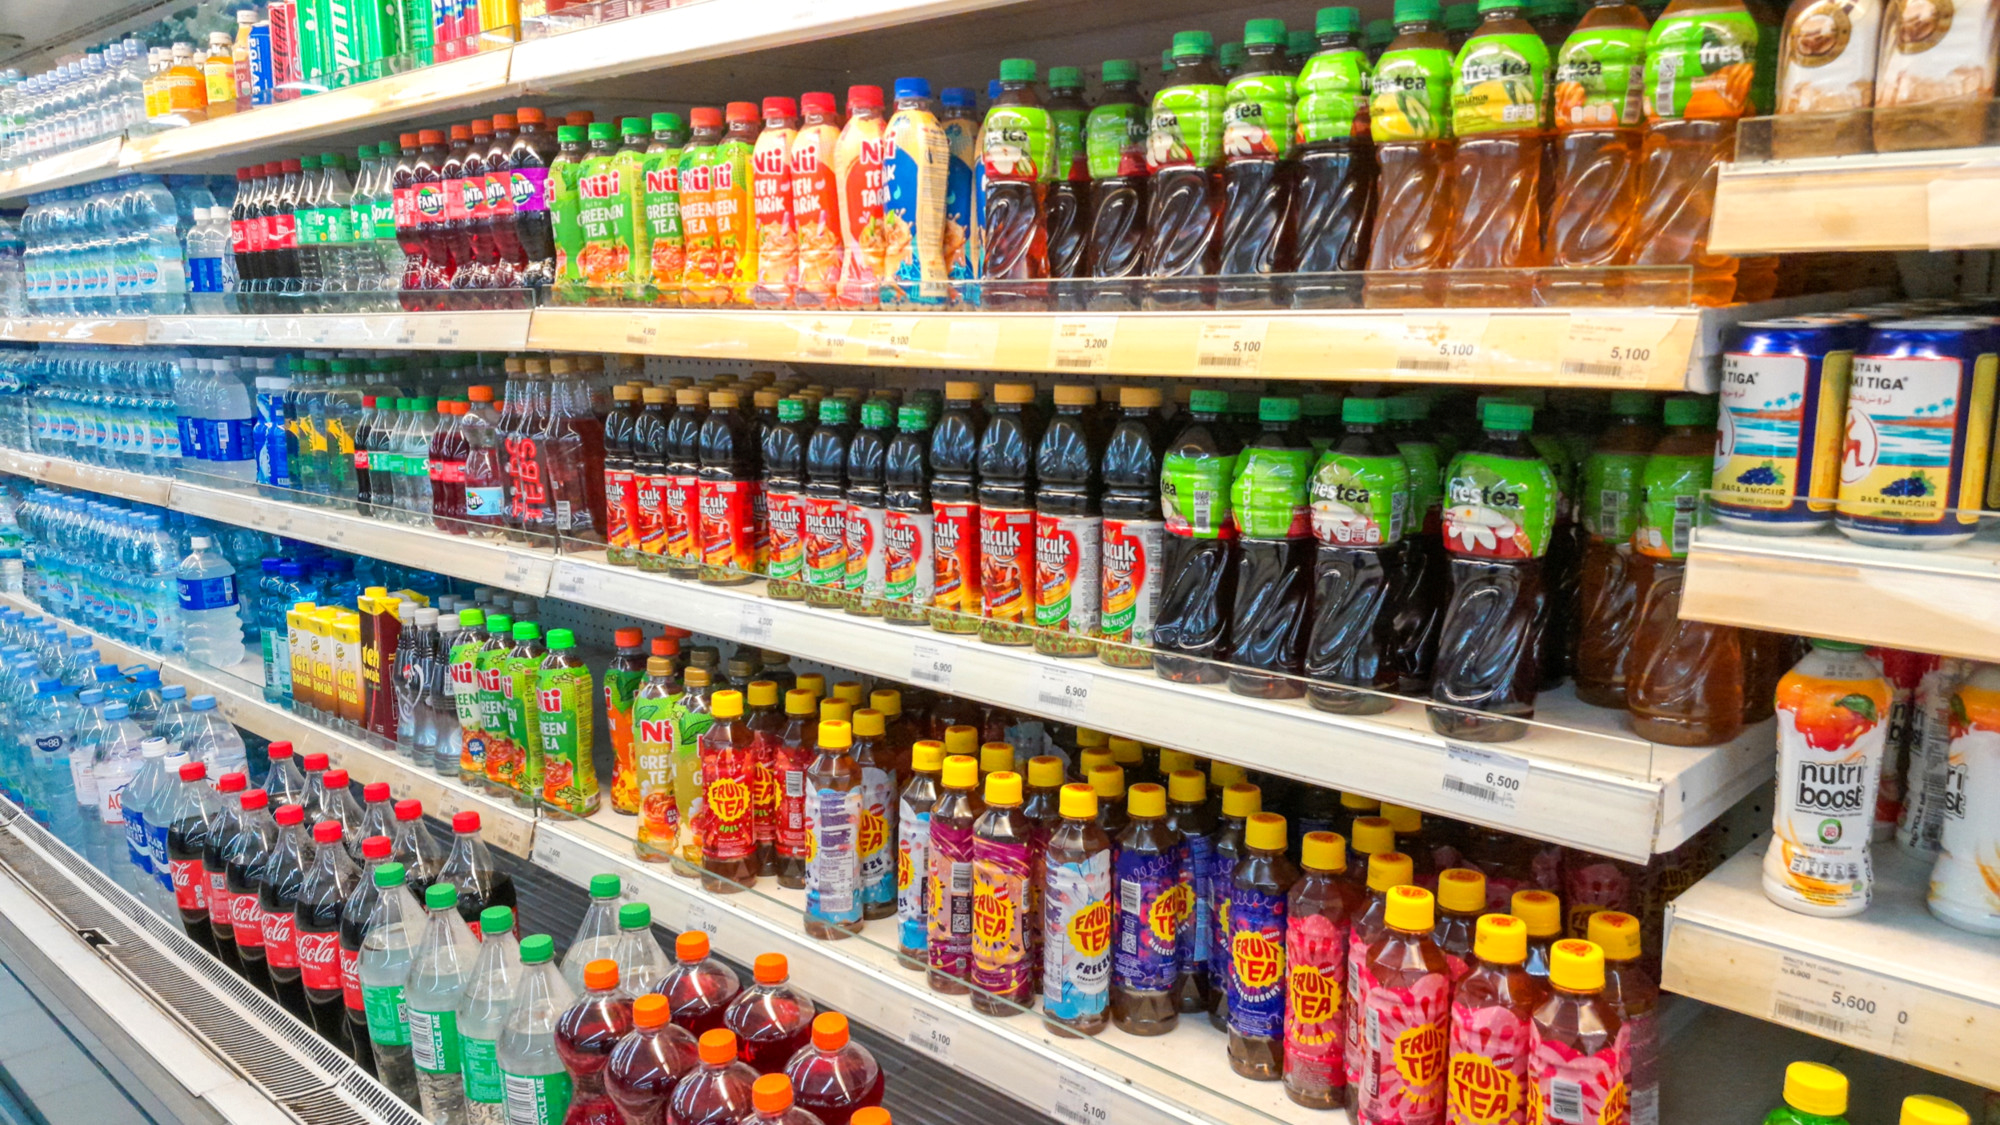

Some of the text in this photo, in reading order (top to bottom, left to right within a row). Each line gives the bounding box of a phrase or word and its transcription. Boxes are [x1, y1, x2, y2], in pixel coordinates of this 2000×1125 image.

[646, 167, 679, 193] Nü
[585, 222, 607, 238] TEA
[652, 218, 678, 235] TEA
[686, 218, 708, 234] TEA
[1084, 338, 1108, 350] 3,200
[1233, 341, 1261, 353] 5,100
[1439, 344, 1474, 356] 5,100
[1610, 346, 1651, 362] 5,100
[1728, 372, 1756, 385] TIGA
[1867, 377, 1904, 391] TIGA
[1311, 475, 1370, 504] frestea
[1450, 478, 1520, 508] frestea
[806, 512, 846, 533] pucuk
[362, 640, 381, 668] teh
[933, 661, 953, 674] 6,900
[476, 668, 501, 692] Nü
[1065, 685, 1088, 699] 6,900
[1486, 772, 1520, 791] 6,500
[1801, 763, 1862, 785] nutri
[711, 783, 745, 799] FRUIT
[1799, 782, 1862, 809] boost
[715, 800, 745, 817] TEA
[974, 893, 1009, 917] FRUIT
[974, 911, 1006, 938] TEA
[299, 932, 338, 964] Cola
[1235, 938, 1280, 961] FRUIT
[1236, 954, 1277, 982] TEA
[1292, 970, 1333, 996] FRUIT
[1293, 991, 1331, 1020] TEA
[1831, 990, 1876, 1015] 5,600
[1897, 1010, 1908, 1025] 0
[431, 1014, 447, 1071] RECYCLE ME
[931, 1030, 951, 1046] 5,100
[1400, 1029, 1444, 1054] FRUIT
[1401, 1054, 1443, 1082] TEA
[1453, 1060, 1513, 1092] FRUIT
[534, 1077, 544, 1095] ME
[1456, 1082, 1509, 1119] TEA
[1083, 1104, 1106, 1121] 5,100
